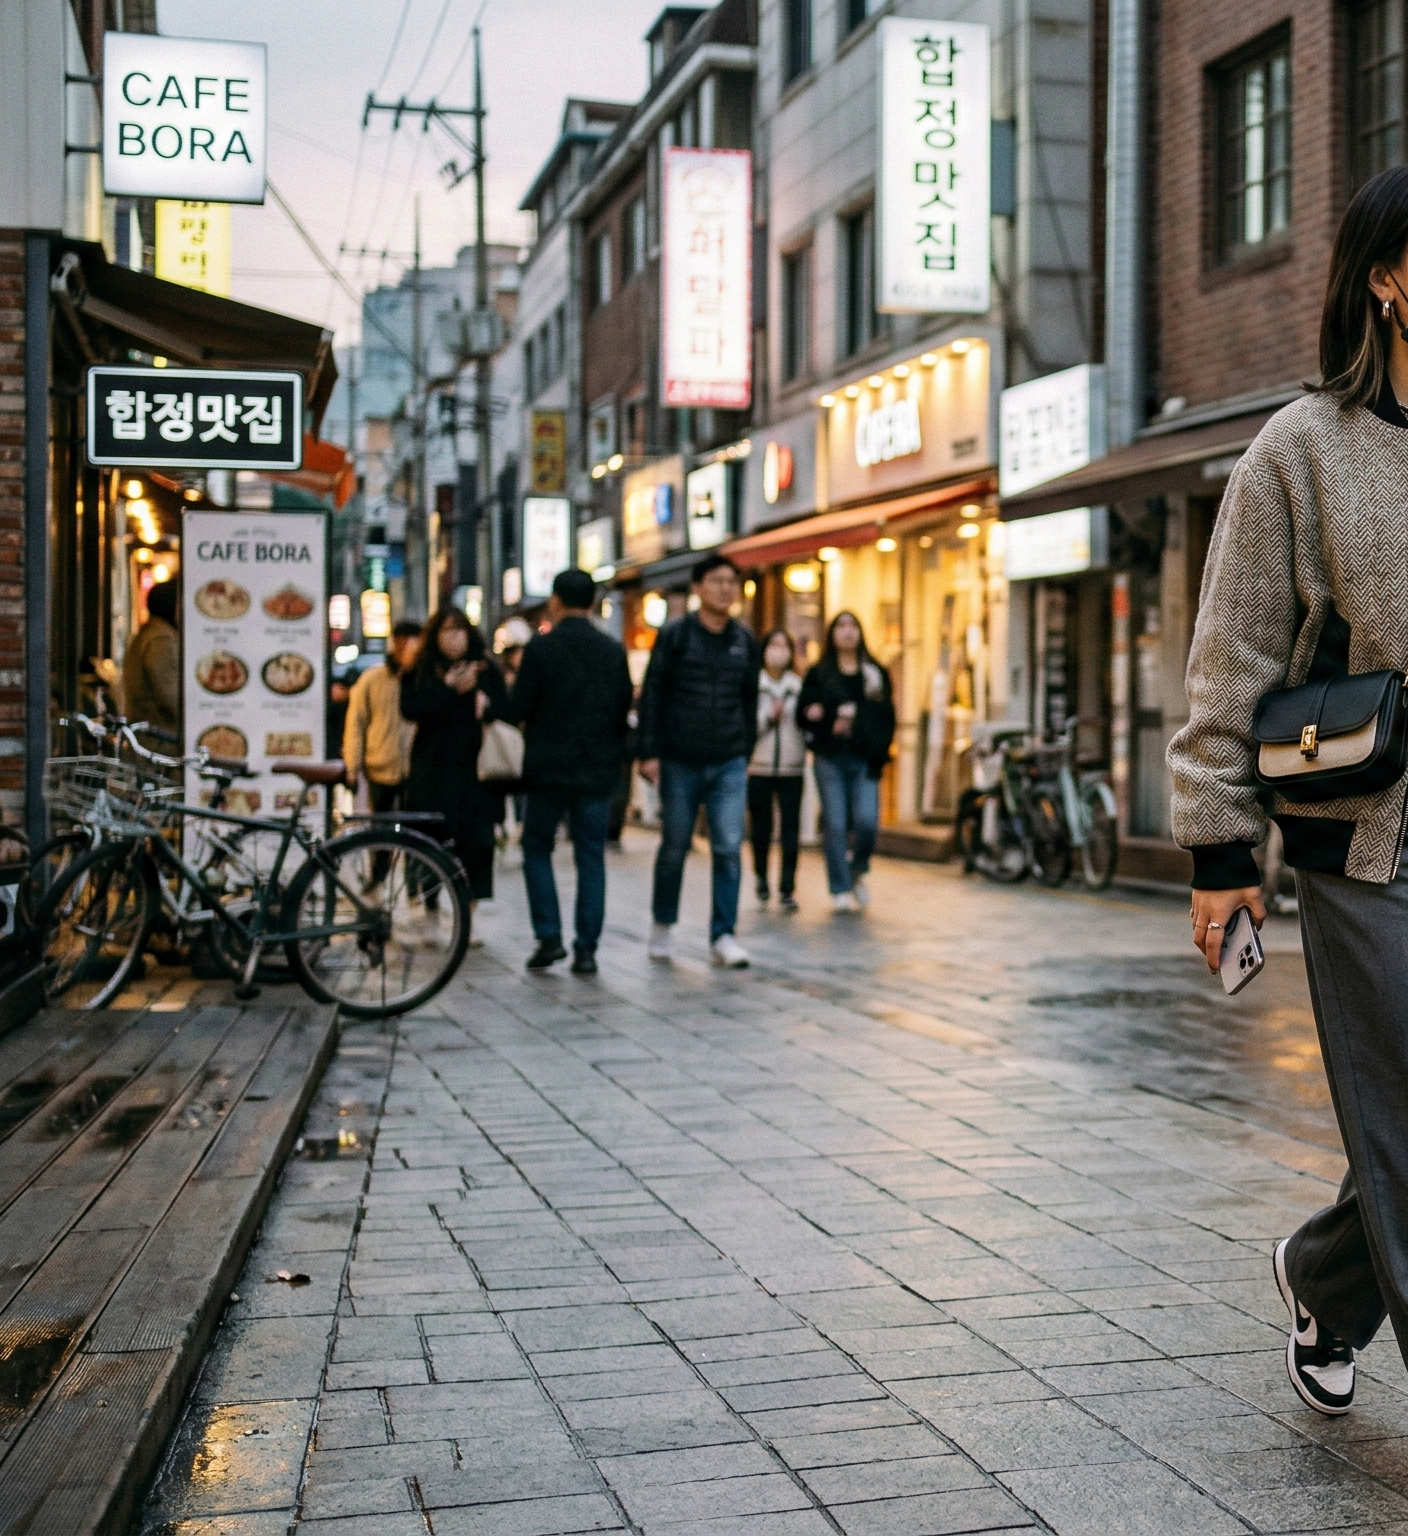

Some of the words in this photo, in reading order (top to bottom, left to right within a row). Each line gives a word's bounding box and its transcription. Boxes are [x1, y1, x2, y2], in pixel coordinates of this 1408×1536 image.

[121, 71, 249, 113] CAFE
[118, 122, 252, 164] BORA
[914, 35, 960, 271] 합정맛집
[105, 389, 283, 444] 합정맛집
[197, 541, 249, 563] CAFE
[255, 541, 312, 564] BORA
